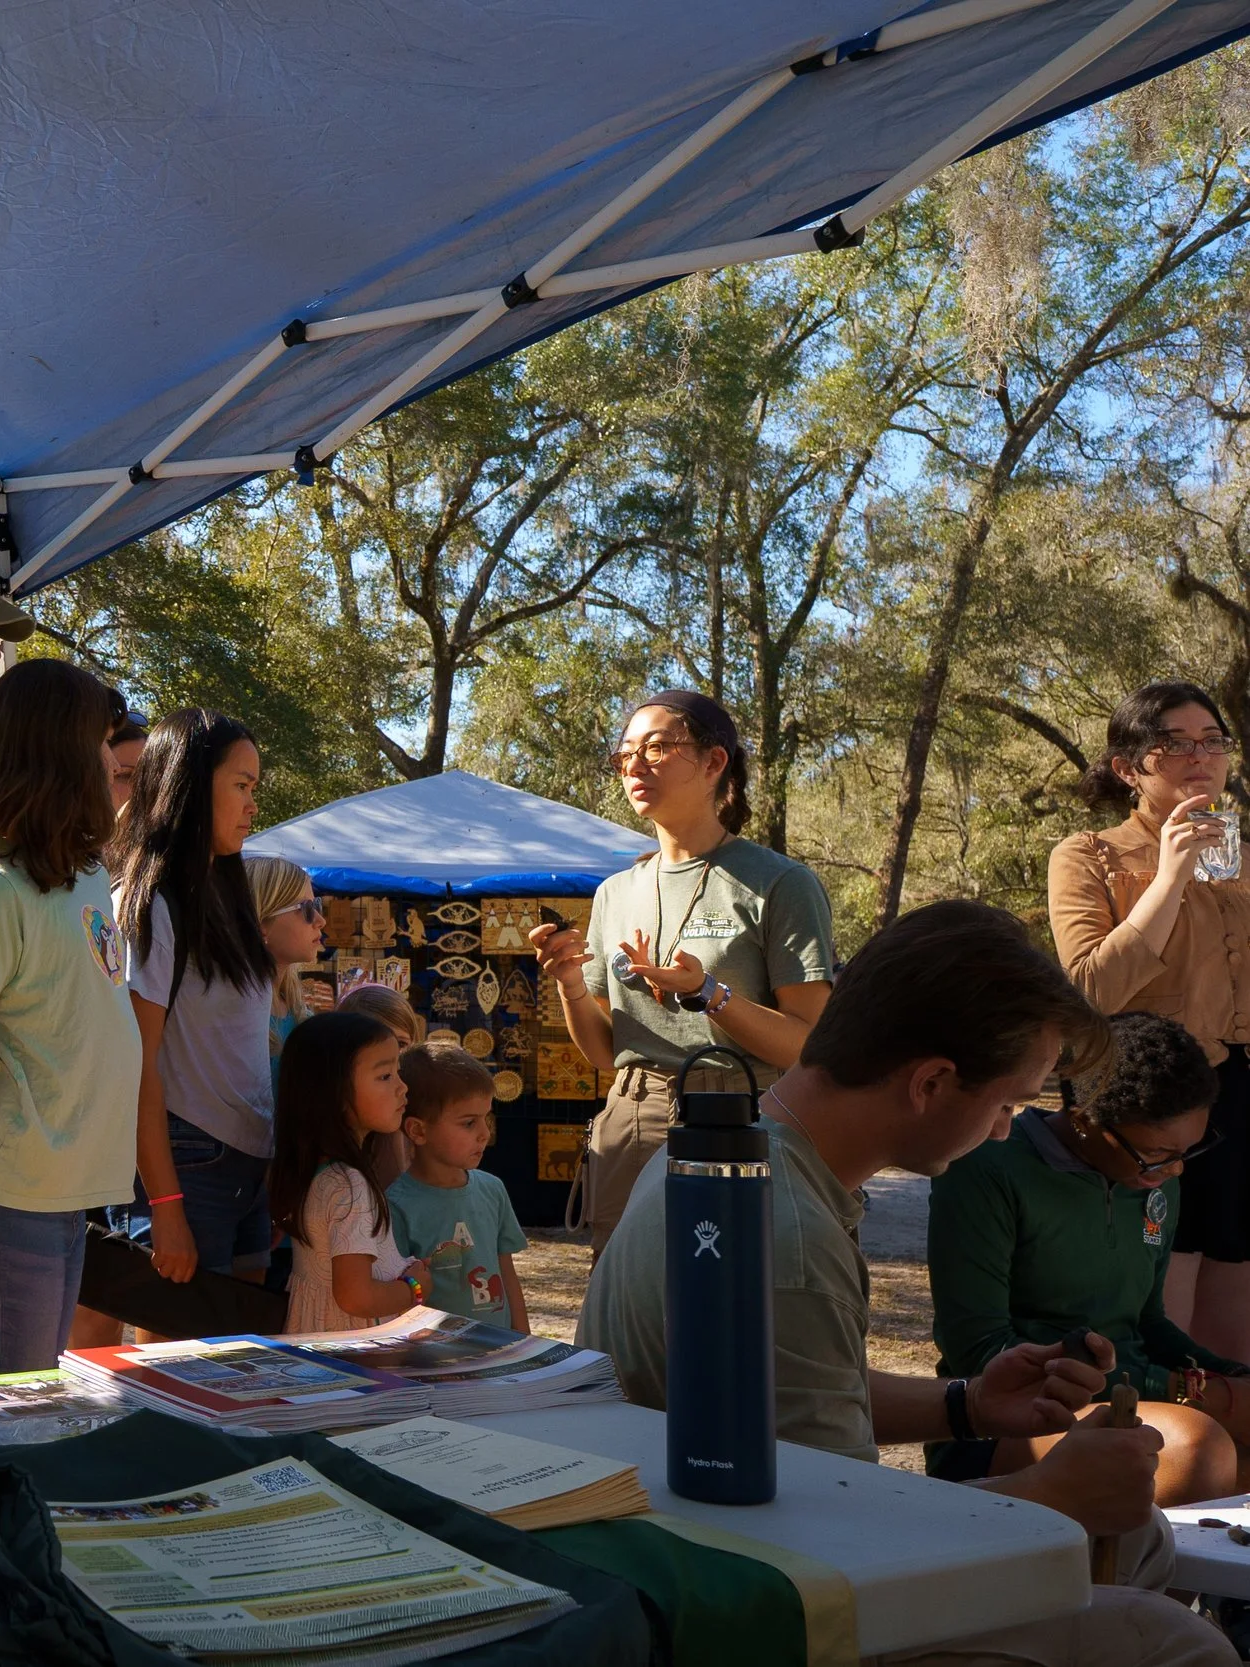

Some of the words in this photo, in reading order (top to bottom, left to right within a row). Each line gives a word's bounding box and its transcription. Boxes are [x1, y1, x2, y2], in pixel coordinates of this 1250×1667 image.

[683, 928, 737, 938] VOLUNTEER
[453, 1221, 475, 1248] A
[687, 1456, 711, 1468] Hydro
[711, 1460, 734, 1470] Flask
[481, 1465, 553, 1489] ARCHAEOLOGY
[510, 1460, 586, 1487] APALACHICOLA
[470, 1482, 508, 1497] VALLEY
[404, 1580, 469, 1596] APPLIED
[265, 1592, 401, 1617] ANTHROPOLOGY
